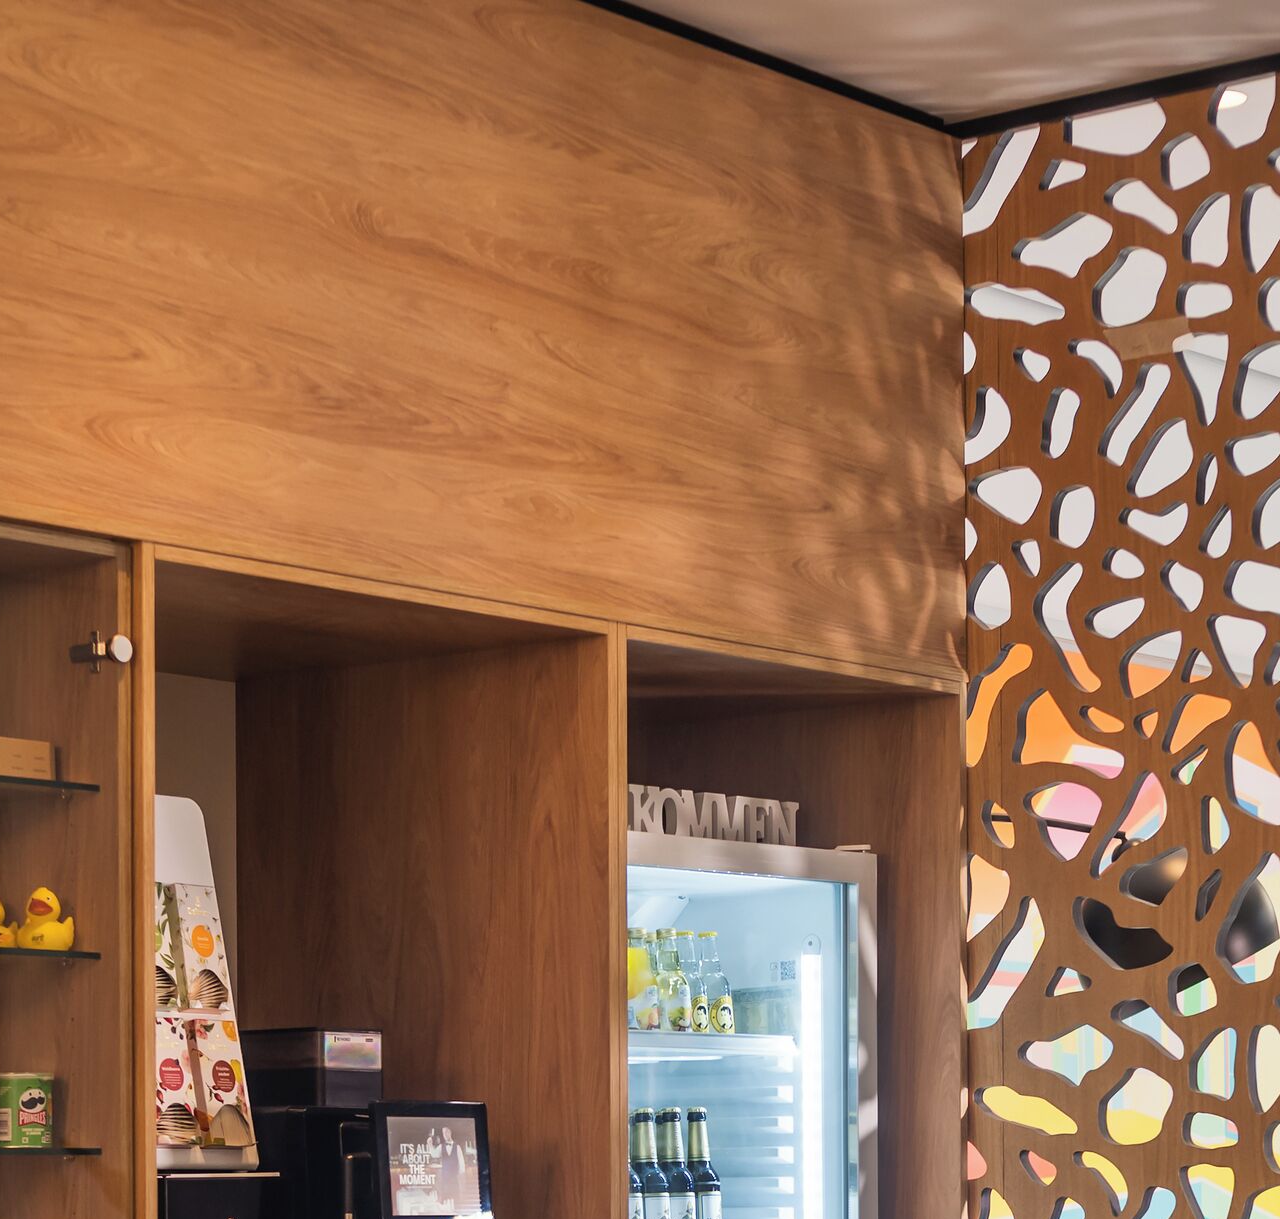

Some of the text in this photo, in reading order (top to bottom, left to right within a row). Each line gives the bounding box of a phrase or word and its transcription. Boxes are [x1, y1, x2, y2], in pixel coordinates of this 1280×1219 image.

[628, 784, 799, 846] KOMMEN
[19, 1111, 47, 1125] PRINGLES
[400, 1143, 432, 1154] IT'S ALL
[403, 1154, 430, 1164] ABOUT
[409, 1164, 425, 1174] THE
[400, 1175, 436, 1185] MOMENT
